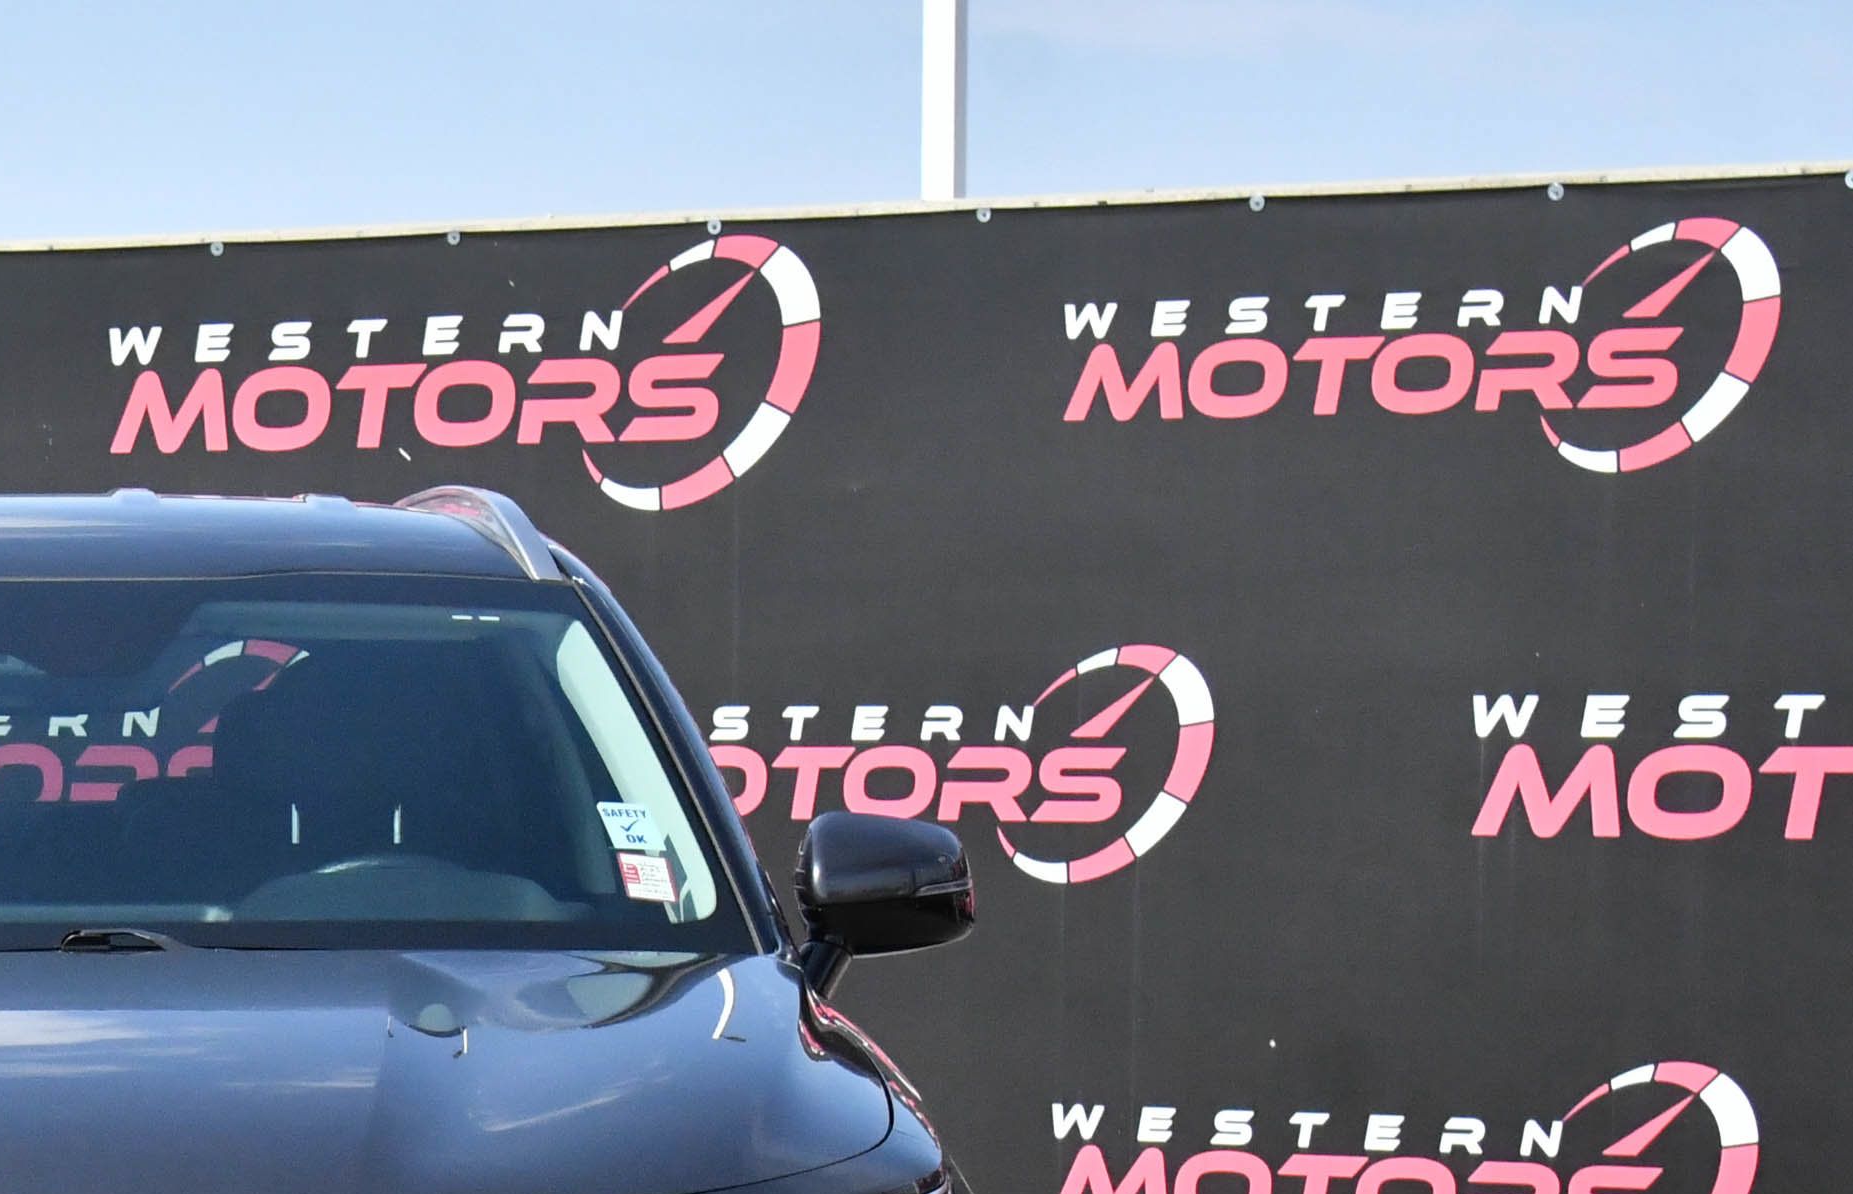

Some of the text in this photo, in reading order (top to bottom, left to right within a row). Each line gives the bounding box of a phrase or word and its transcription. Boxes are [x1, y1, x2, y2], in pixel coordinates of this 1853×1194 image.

[109, 310, 623, 366] WESTERN
[1064, 286, 1583, 340] WESTERN
[1063, 326, 1684, 422] MOTORS
[110, 353, 725, 454] MOTORS
[709, 706, 1034, 741] STERN
[1472, 694, 1826, 739] WEST
[602, 807, 647, 819] SAFETY
[1471, 744, 1853, 840] MOT
[626, 834, 648, 844] OK
[1052, 1103, 1563, 1157] WESTERN
